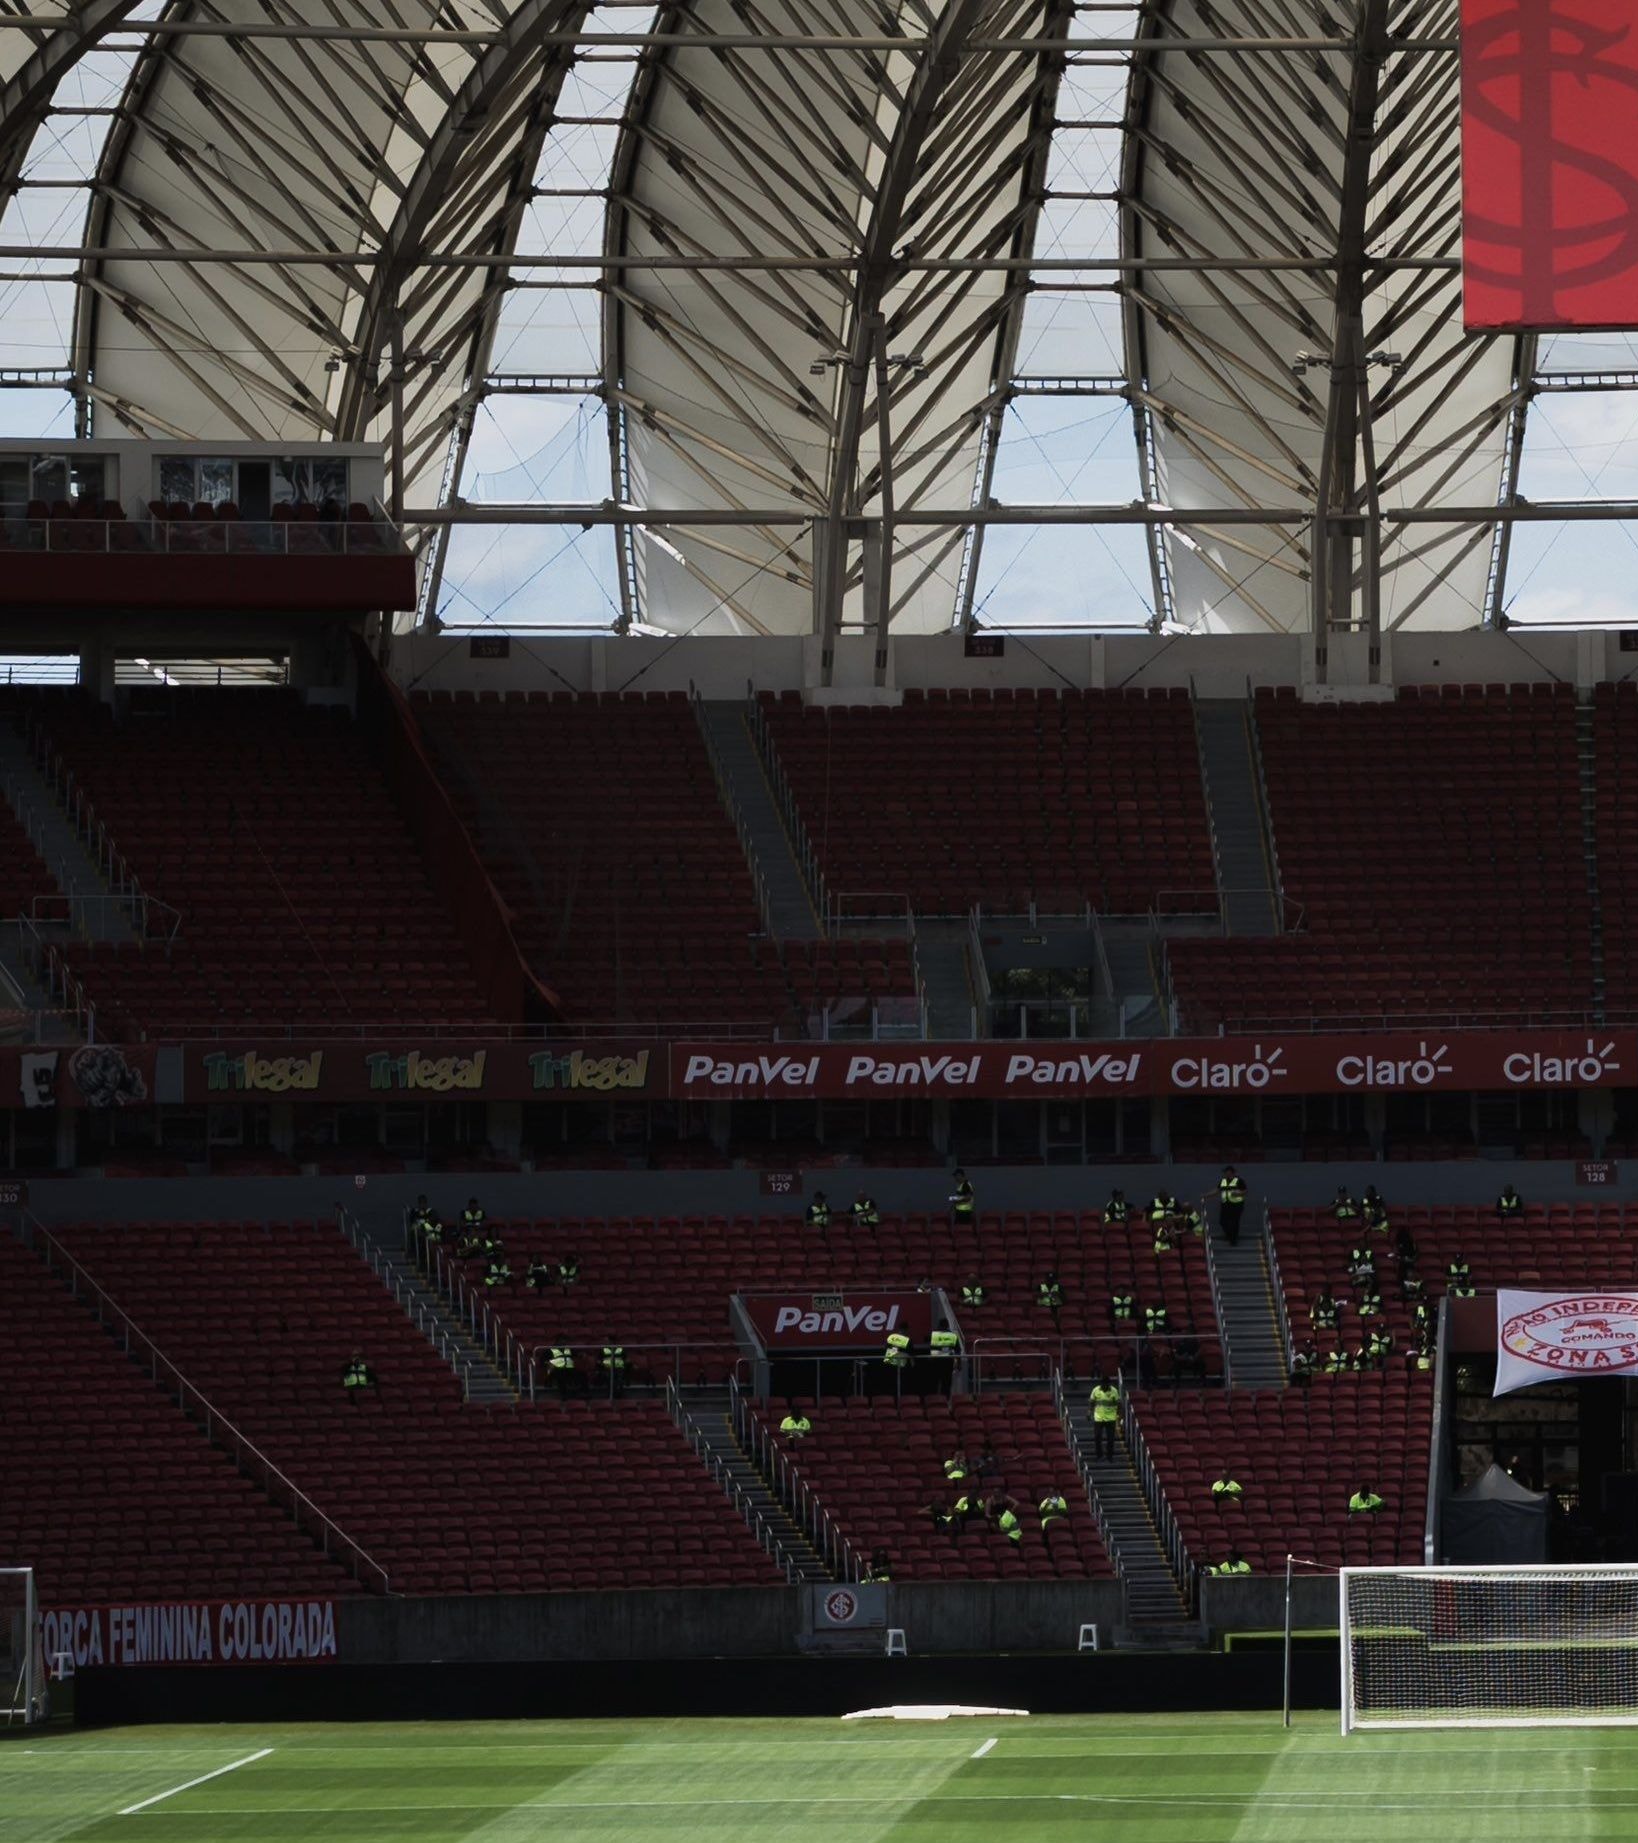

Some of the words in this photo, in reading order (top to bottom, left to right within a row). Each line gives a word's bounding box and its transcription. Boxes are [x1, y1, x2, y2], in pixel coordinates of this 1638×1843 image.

[202, 1049, 323, 1092] Trilegal
[365, 1049, 487, 1092] Trilegal
[528, 1049, 649, 1092] Trilegal
[683, 1055, 821, 1085] PanVel
[844, 1055, 983, 1085] PanVel
[1004, 1054, 1142, 1084] PanVel
[1170, 1057, 1270, 1088] Claro
[1335, 1055, 1435, 1086] Claro
[1502, 1051, 1602, 1083] Claro
[767, 1173, 793, 1181] SETOR
[1582, 1163, 1609, 1172] SETOR
[1586, 1172, 1606, 1182] 128
[771, 1182, 791, 1192] 129
[774, 1304, 900, 1333] PanVel
[1561, 1332, 1636, 1344] COMANDO
[1527, 1343, 1611, 1367] ZONA
[108, 1605, 213, 1665] FEMININA
[218, 1601, 337, 1660] COLORADA
